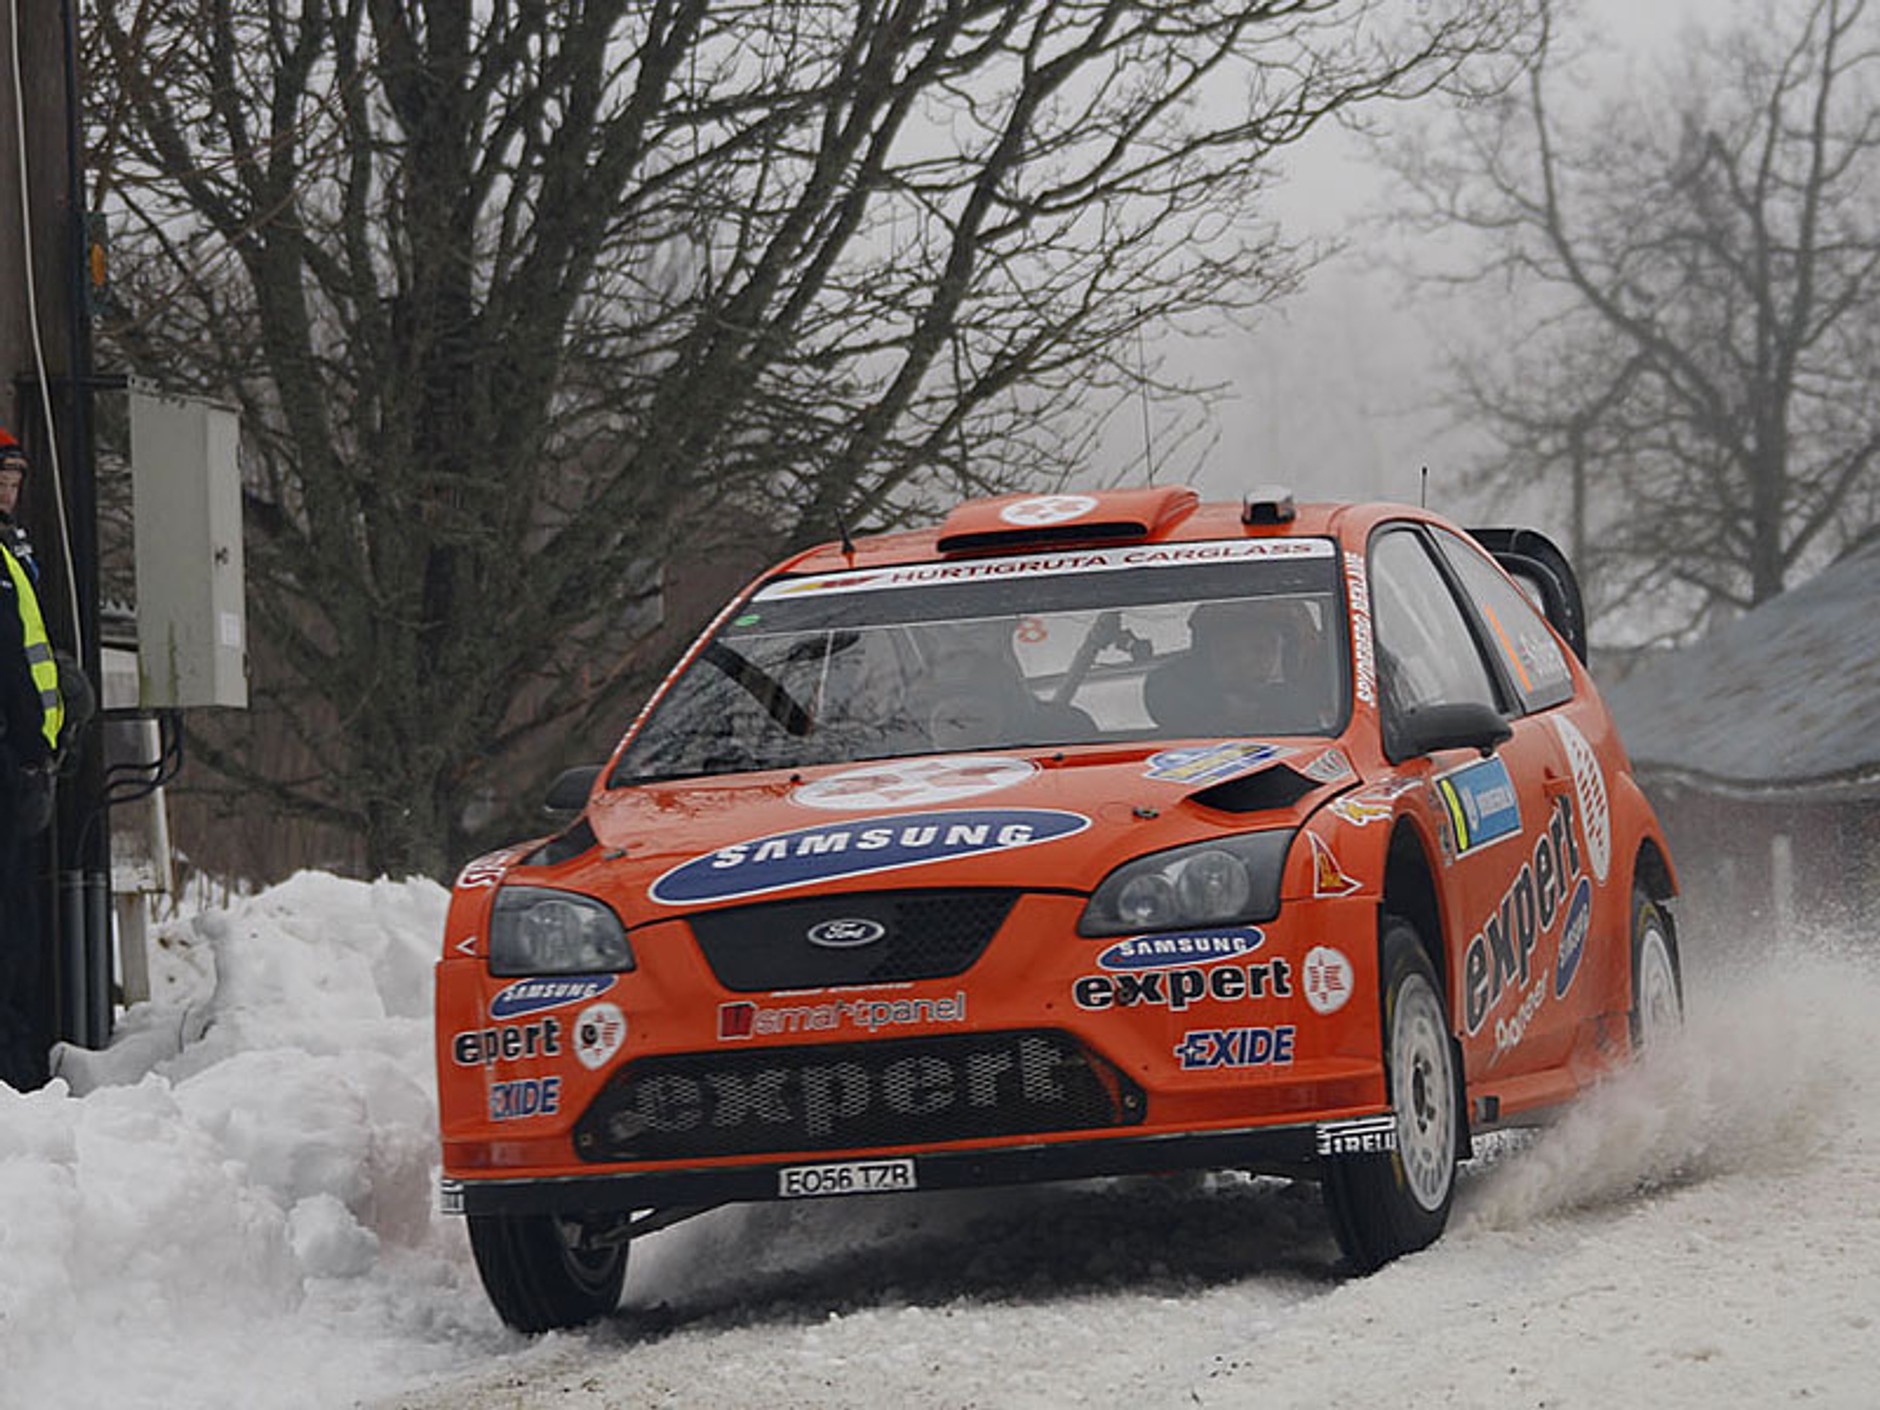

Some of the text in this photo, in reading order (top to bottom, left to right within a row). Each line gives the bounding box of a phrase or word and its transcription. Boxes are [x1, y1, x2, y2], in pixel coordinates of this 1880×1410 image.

[892, 544, 1311, 583] HURTIGRUTA CARGLASS
[711, 823, 1034, 869] SAMSUNG
[1467, 795, 1580, 1036] expert
[1119, 935, 1248, 956] SAMSUNG
[503, 983, 598, 1001] SAMSUNG
[1073, 957, 1292, 1011] expert
[755, 991, 966, 1034] smartpanel
[1178, 1026, 1296, 1069] EXIDE
[489, 1077, 562, 1121] EXIDE
[635, 1036, 1065, 1136] expert
[786, 1164, 909, 1194] EO56 TZR
